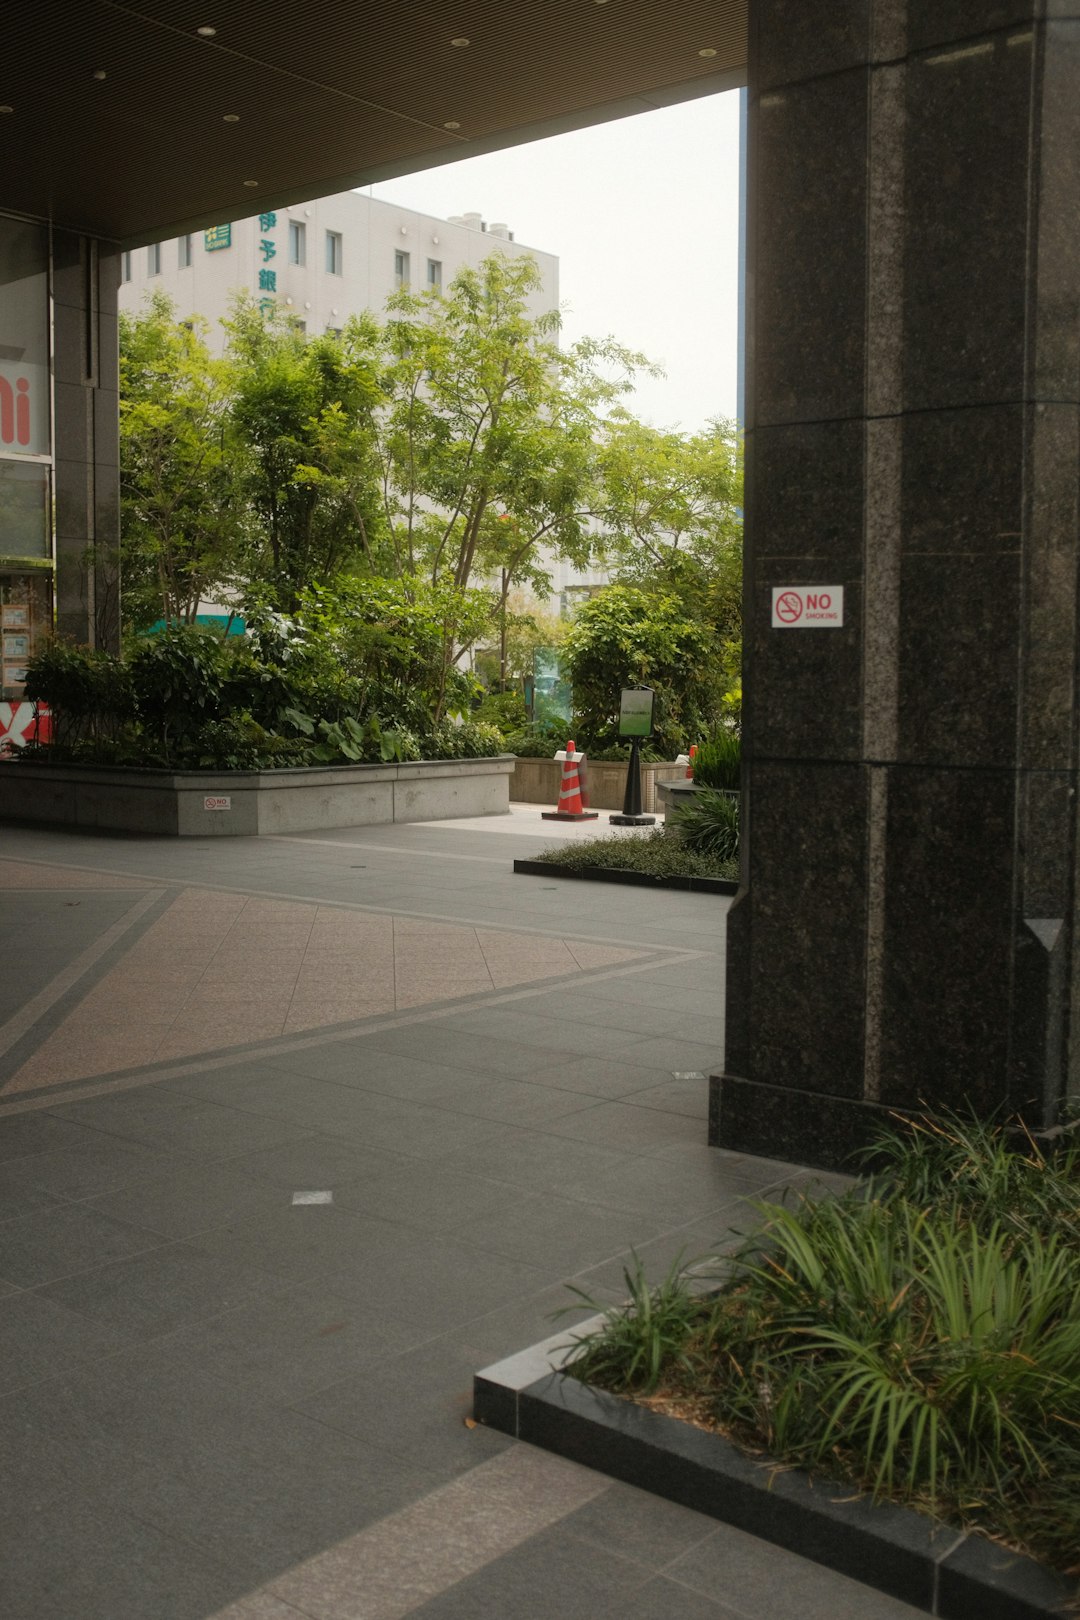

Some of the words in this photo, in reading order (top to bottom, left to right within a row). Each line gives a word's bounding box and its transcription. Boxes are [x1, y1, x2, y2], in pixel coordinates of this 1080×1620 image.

[259, 212, 276, 320] 伊予銀行
[806, 594, 832, 610] NO
[806, 612, 838, 620] SMOKING
